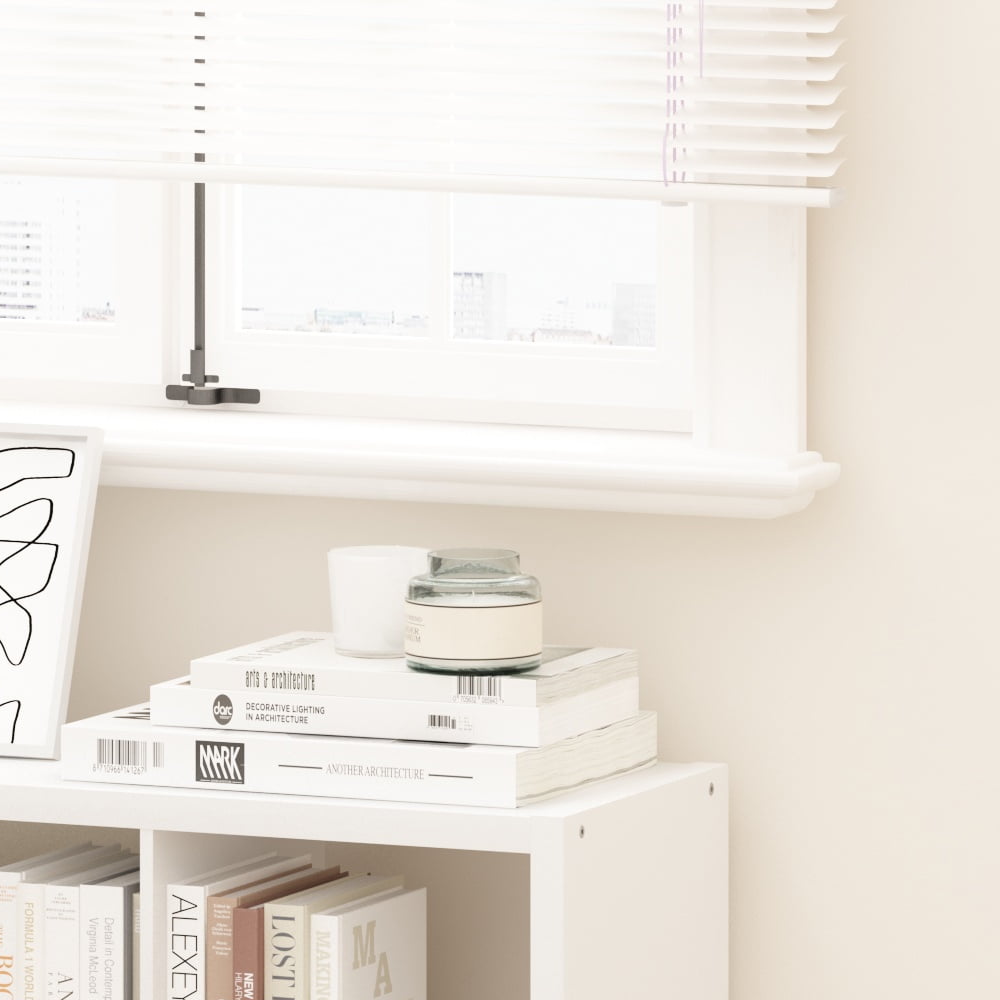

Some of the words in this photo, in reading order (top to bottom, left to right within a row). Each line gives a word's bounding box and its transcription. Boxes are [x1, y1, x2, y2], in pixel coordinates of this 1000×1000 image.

[244, 670, 260, 689] arts
[263, 672, 269, 689] &
[271, 670, 316, 691] architecture
[214, 701, 233, 715] darc
[245, 702, 291, 713] DECORATIVE
[292, 704, 326, 715] LIGHTING
[245, 713, 253, 721] IN
[255, 714, 309, 725] ARCHITECTURE
[198, 743, 242, 780] MARK
[326, 763, 364, 777] ANOTHER
[364, 764, 425, 781] ARCHITECTURE
[24, 902, 35, 954] FORMULA
[87, 917, 99, 953] Virginia
[104, 917, 115, 945] Detail
[104, 947, 114, 956] in
[271, 915, 296, 988] LOST
[89, 955, 99, 994] McLeod
[243, 972, 254, 999] NEW
